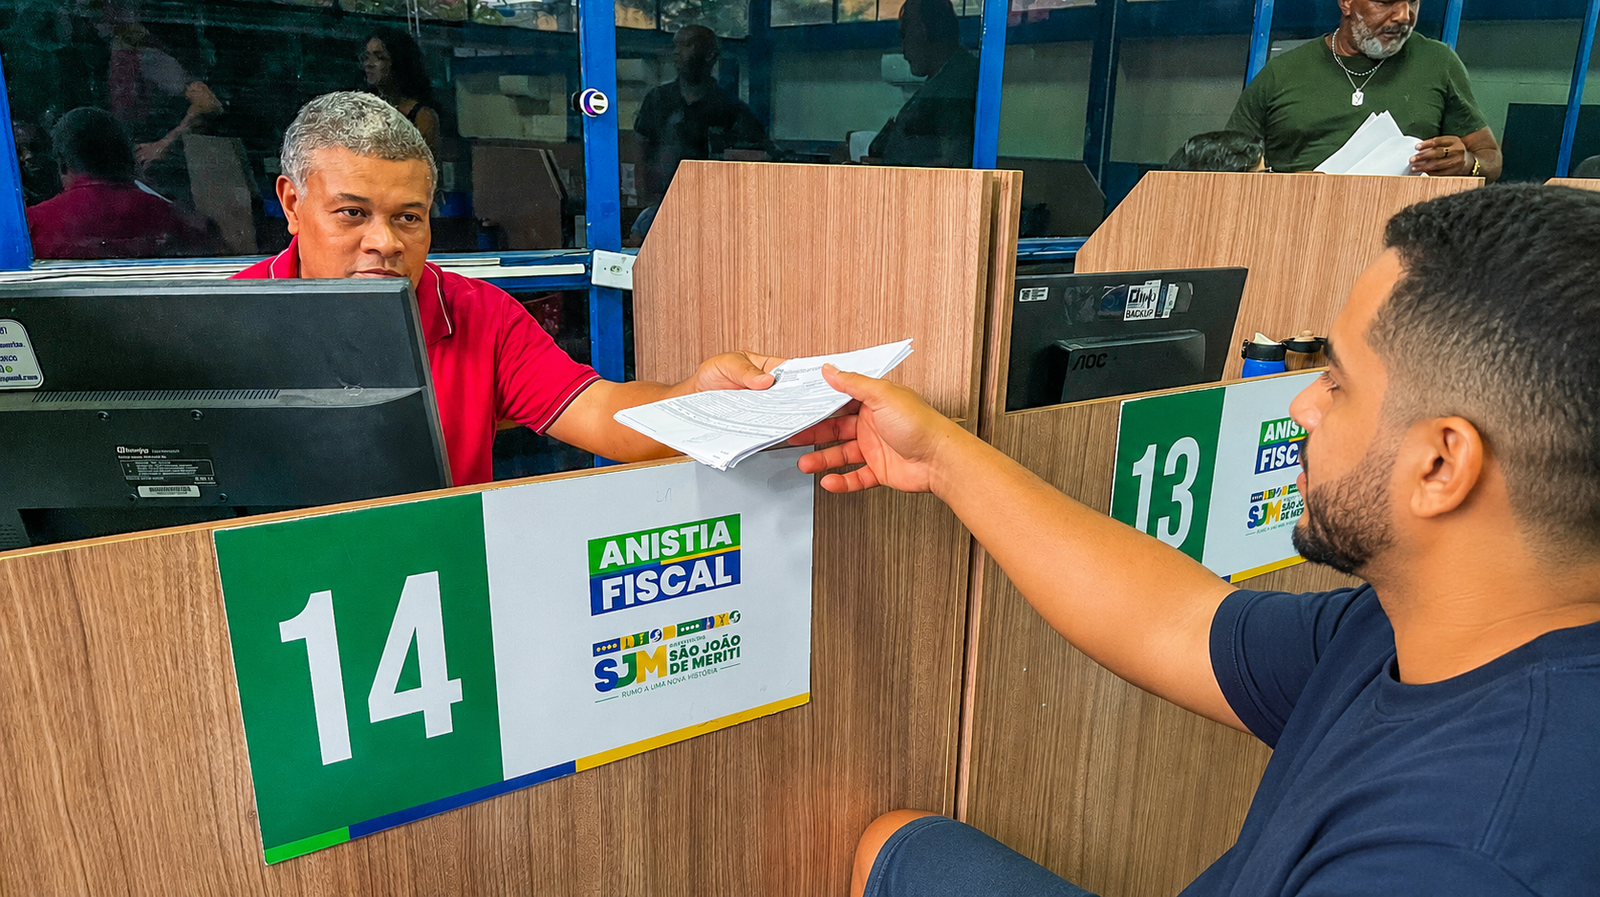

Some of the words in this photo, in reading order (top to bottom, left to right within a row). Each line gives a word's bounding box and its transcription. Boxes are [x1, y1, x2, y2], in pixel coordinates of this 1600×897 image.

[1072, 353, 1108, 371] AOC
[1260, 443, 1299, 471] FISC
[1132, 436, 1200, 549] 13
[1247, 499, 1282, 529] SJM
[599, 520, 732, 569] ANISTIA
[602, 556, 732, 610] FISCAL
[669, 644, 700, 662] SÃO
[702, 633, 741, 654] JOÃO
[669, 659, 689, 675] DE
[692, 646, 741, 670] MERITI
[279, 571, 463, 765] 14
[594, 645, 668, 692] SJM
[621, 687, 643, 698] RUMO
[667, 676, 686, 686] NOVA
[687, 667, 718, 680] HISTÓRIA
